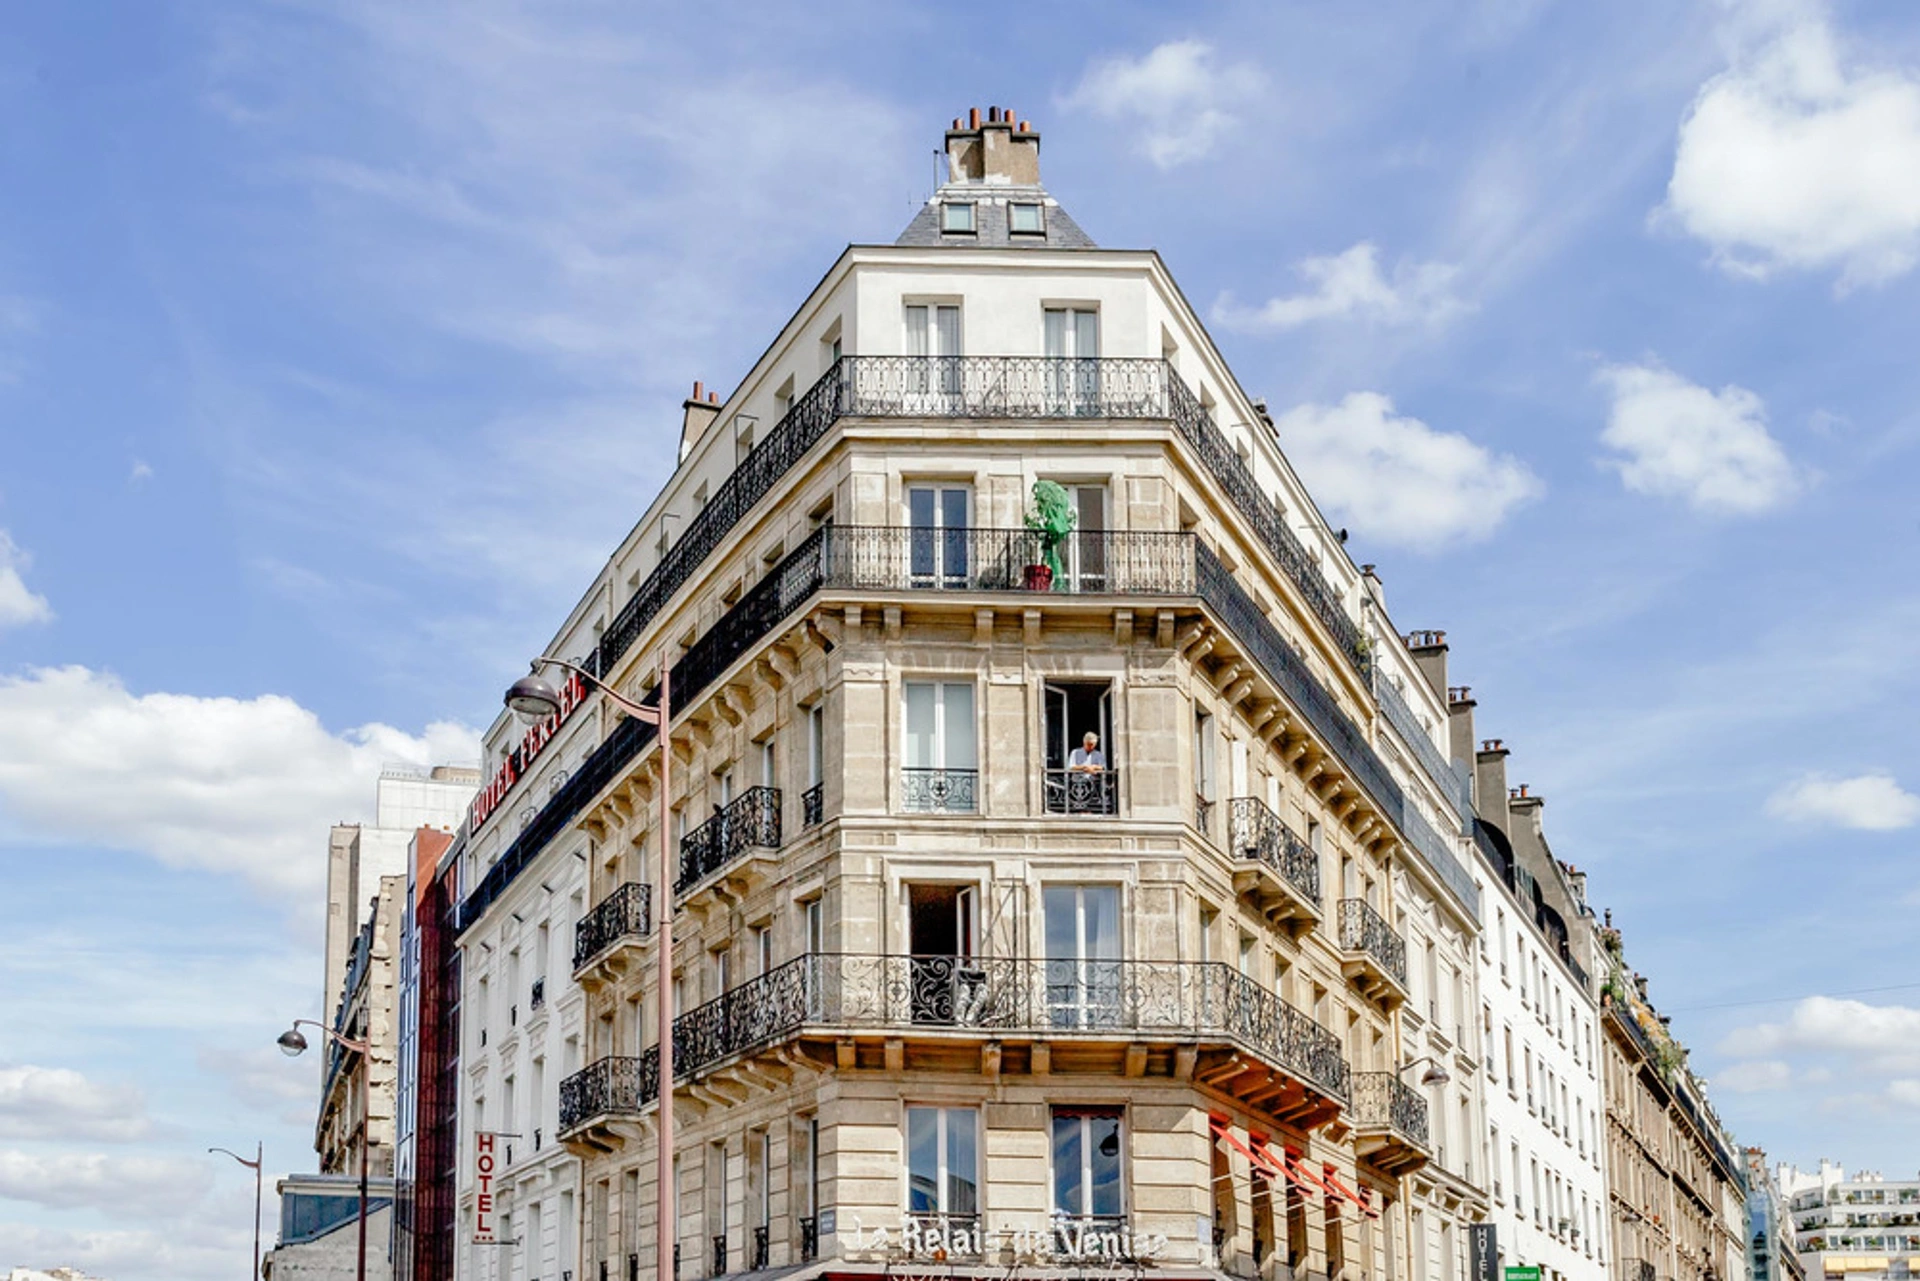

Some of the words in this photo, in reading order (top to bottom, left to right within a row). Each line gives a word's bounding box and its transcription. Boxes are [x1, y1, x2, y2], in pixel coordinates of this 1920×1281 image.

[473, 754, 517, 832] HOTEL
[477, 1134, 494, 1232] HOTEL
[900, 1214, 1002, 1255] Relais
[1056, 1221, 1169, 1259] Venise
[1477, 1228, 1488, 1281] HOTEL
